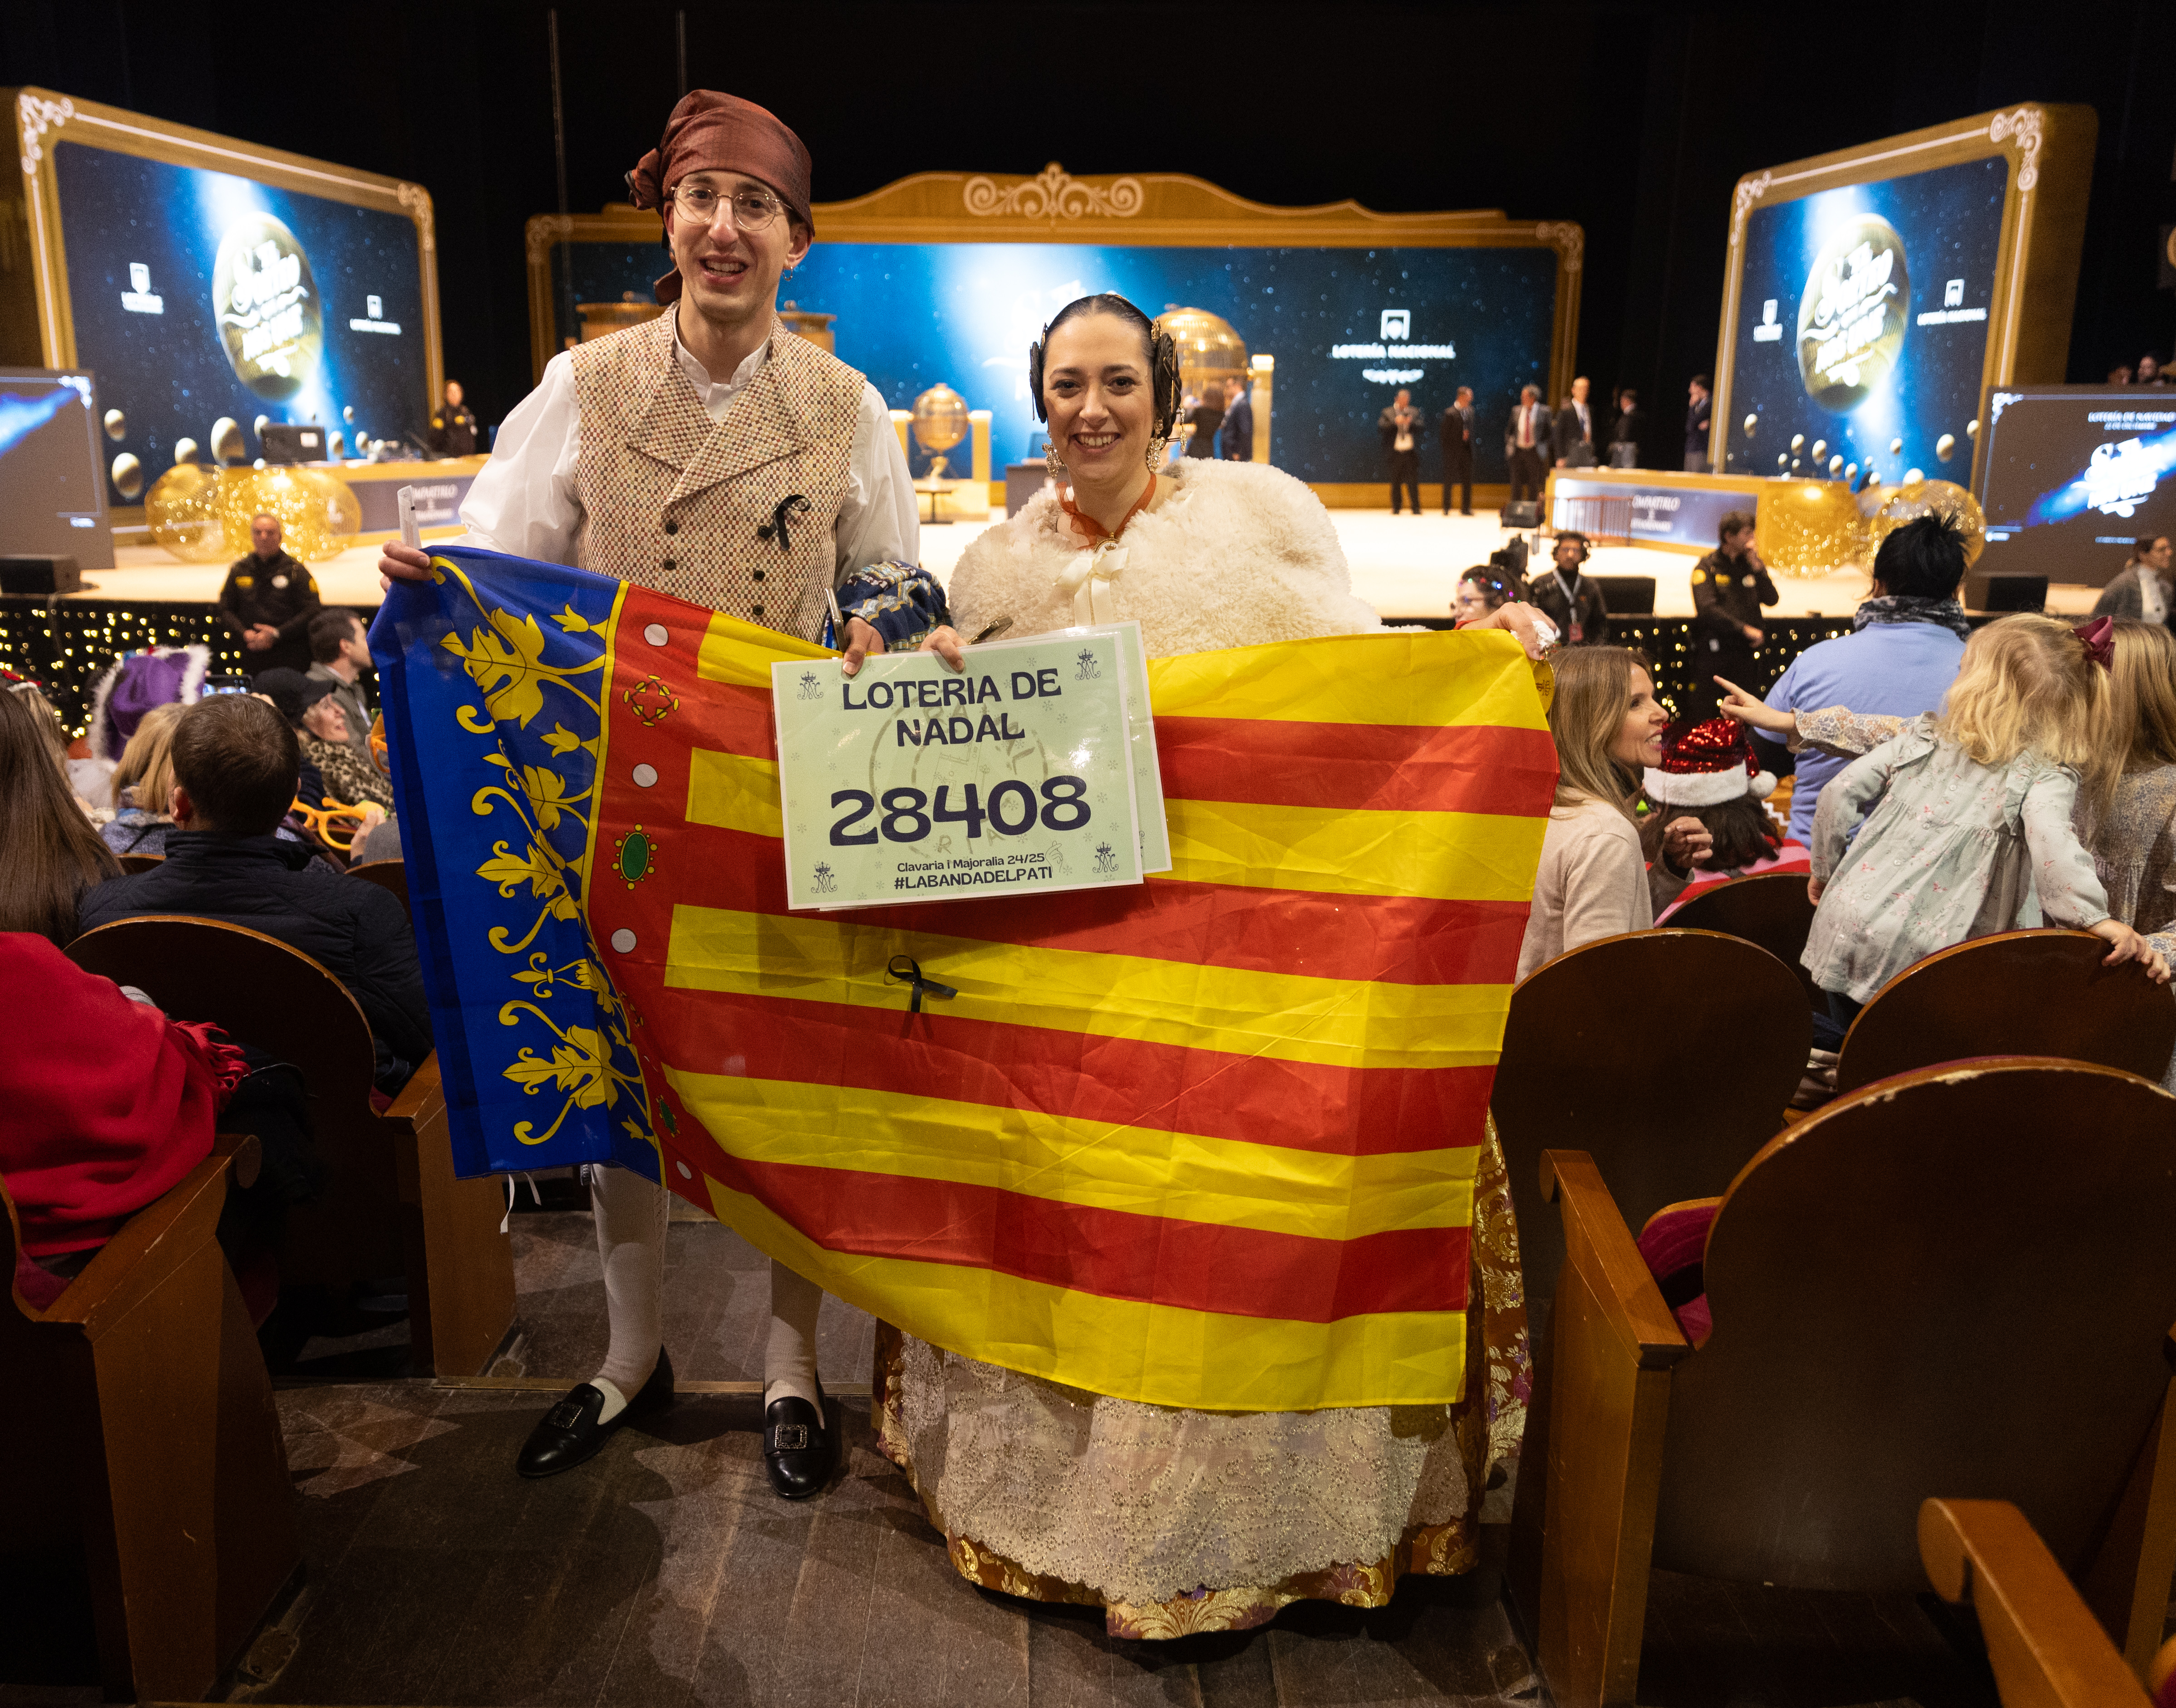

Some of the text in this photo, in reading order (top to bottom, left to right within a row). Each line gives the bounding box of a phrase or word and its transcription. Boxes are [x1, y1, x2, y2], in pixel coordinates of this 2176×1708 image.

[843, 668, 1062, 710] LOTERIA DE
[897, 713, 1025, 746] NADAL
[830, 775, 1091, 846] 28408
[894, 866, 1053, 890] #LABANDADELPATI
[897, 853, 1045, 872] Clavaria i Majoralia 24/25
